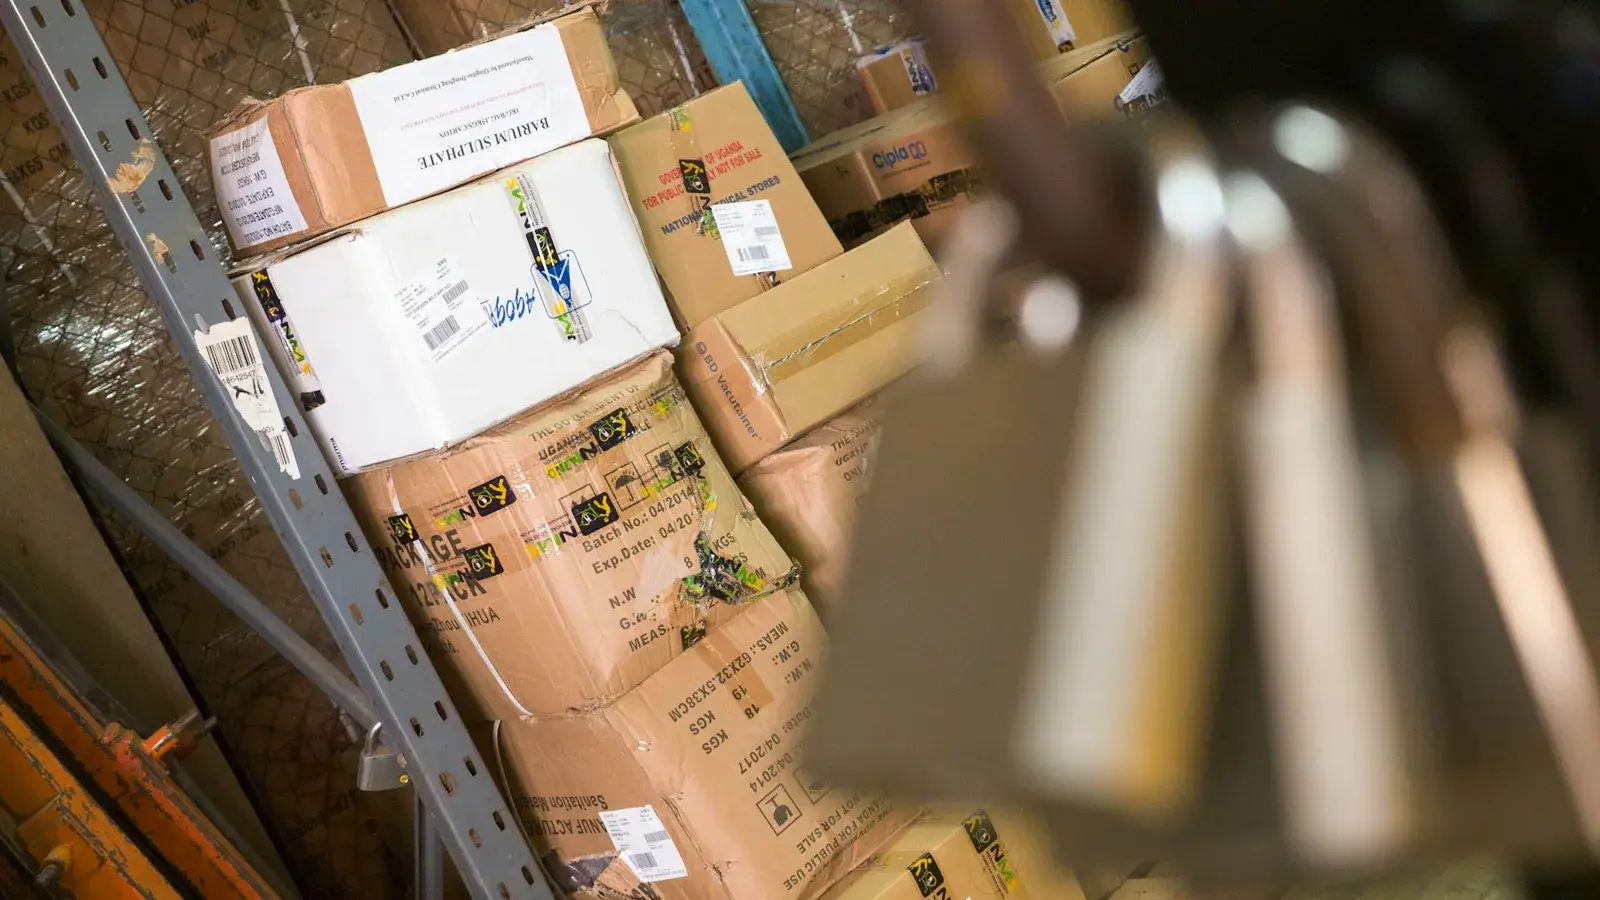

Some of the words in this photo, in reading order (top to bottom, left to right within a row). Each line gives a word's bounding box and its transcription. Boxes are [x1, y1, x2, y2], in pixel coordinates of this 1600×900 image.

[495, 116, 550, 144] BARIUM
[417, 135, 492, 170] SULPHATE
[705, 152, 716, 165] OF
[715, 140, 745, 161] UGANDA
[872, 145, 910, 170] Cipla
[642, 196, 659, 211] FOR
[661, 183, 685, 204] PUBLIC
[714, 162, 731, 177] NOT
[730, 155, 745, 171] FOR
[744, 147, 763, 162] SALE
[747, 175, 781, 196] STORES
[272, 220, 293, 236] BATCH
[703, 354, 719, 374] BD
[716, 373, 760, 440] Vacutainer
[529, 427, 554, 443] THE
[626, 383, 641, 397] OF
[538, 430, 588, 461] UGANDA
[829, 435, 851, 453] THE
[434, 504, 477, 530] NMS
[581, 522, 622, 553] Batch
[621, 511, 649, 533] No.:
[648, 485, 696, 518] 04/2014
[591, 534, 656, 575] Exp.Date:
[683, 555, 694, 570] 8
[711, 531, 737, 552] KGS
[628, 622, 675, 652] MEAS.:
[749, 620, 789, 656] MEAS.:
[771, 640, 800, 666] G.W.:
[783, 657, 813, 685] N.W.:
[667, 651, 752, 723] 62X32.5X38CM
[732, 684, 748, 701] 19
[689, 709, 717, 736] KGS
[744, 702, 760, 720] 18
[701, 728, 730, 755] KGS
[738, 732, 782, 775] 04/2017
[749, 751, 794, 794] 04/2014
[549, 794, 609, 812] Sanitation
[843, 792, 861, 816] NOT
[820, 808, 842, 832] FOR
[840, 820, 859, 843] FOR
[796, 827, 825, 855] SALE
[804, 836, 840, 873] PUBLIC
[783, 869, 807, 891] USE
